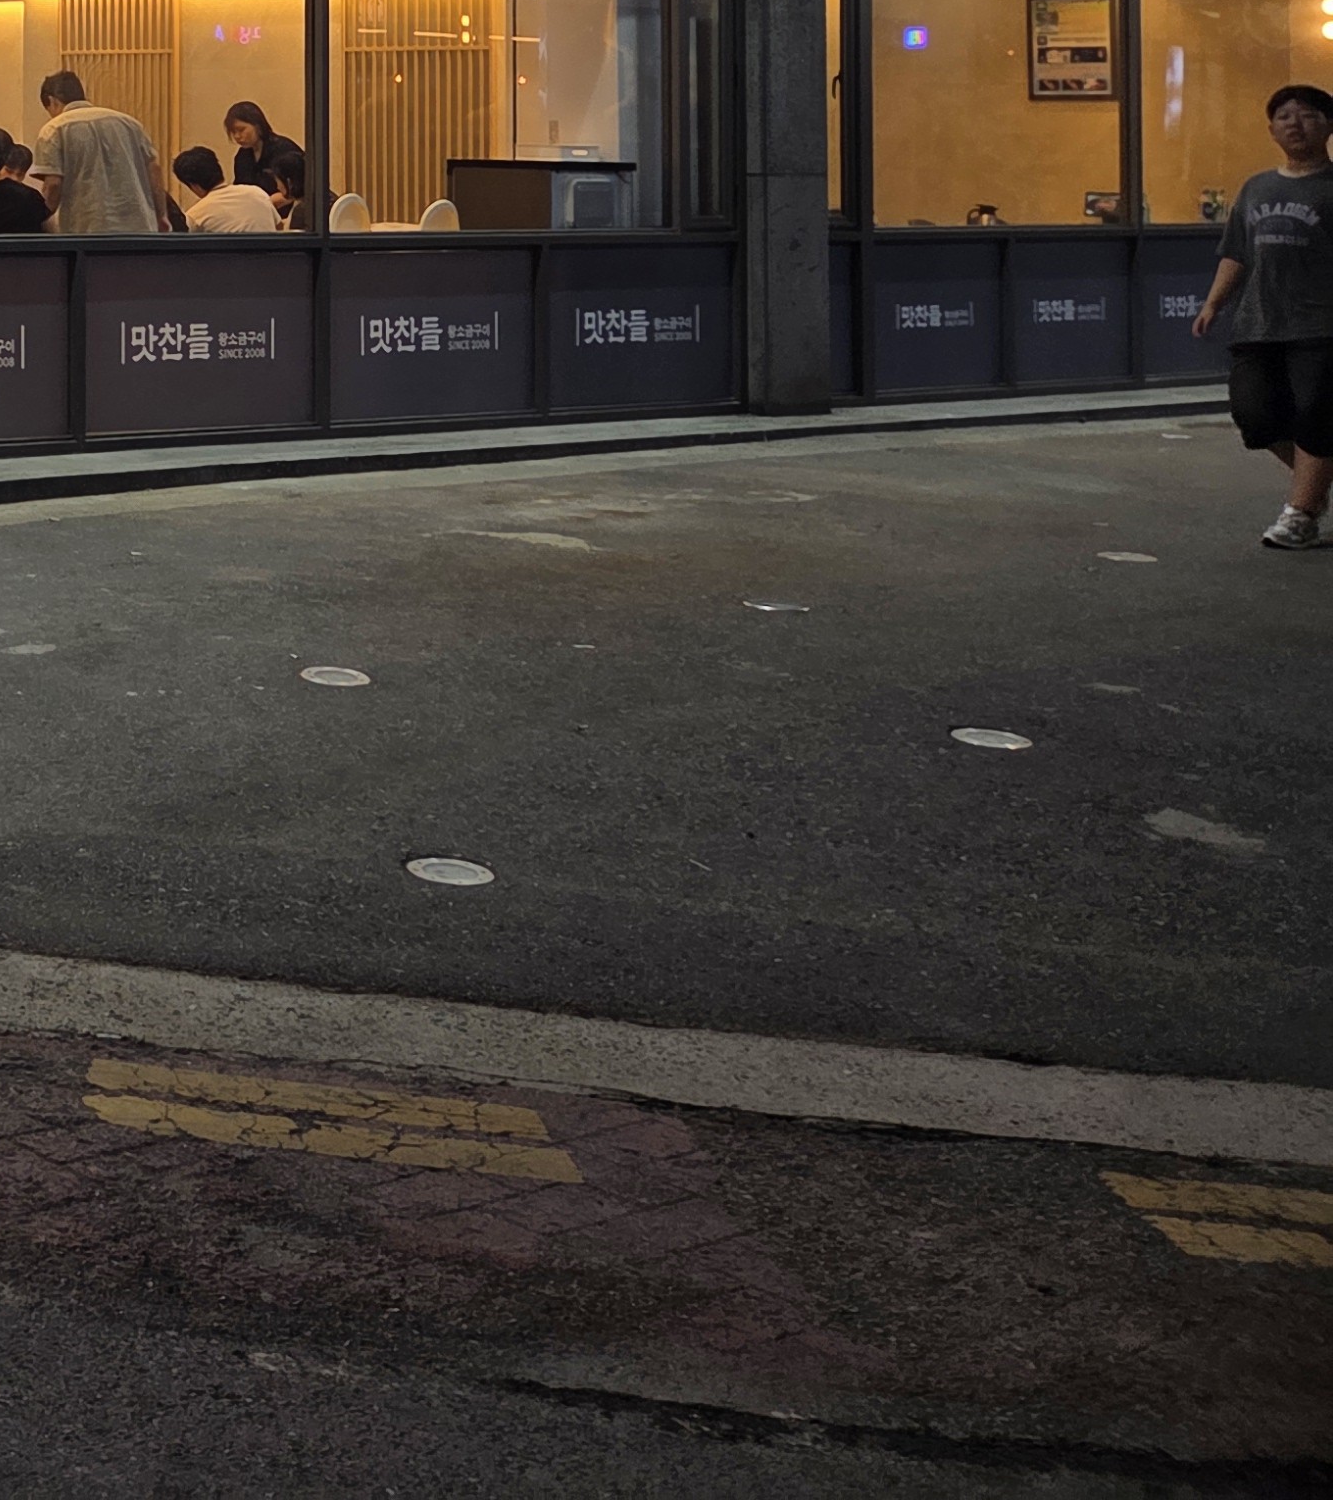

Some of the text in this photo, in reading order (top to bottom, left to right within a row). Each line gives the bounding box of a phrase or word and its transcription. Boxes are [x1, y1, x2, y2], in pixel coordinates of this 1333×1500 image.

[901, 304, 942, 328] 맛찬들
[1038, 299, 1076, 322] 맛찬들
[369, 315, 444, 353] 맛찬들
[583, 308, 650, 344] 맛찬들
[130, 322, 266, 362] 맛찬들 왕소금구이
[218, 347, 266, 360] SINCE 2008
